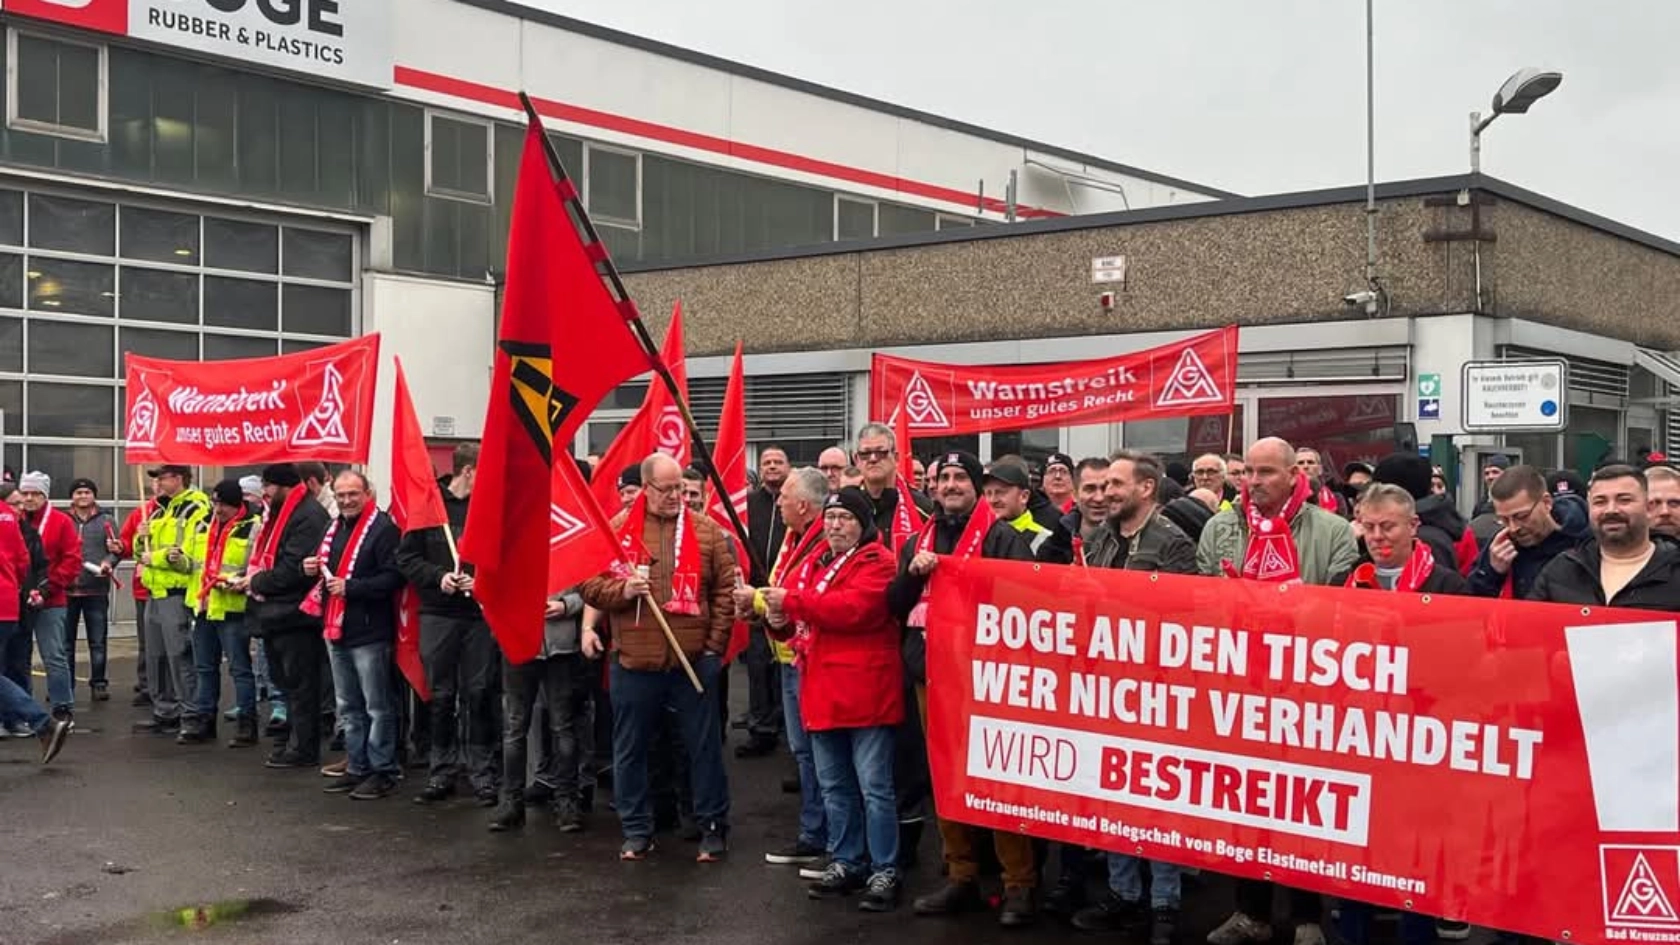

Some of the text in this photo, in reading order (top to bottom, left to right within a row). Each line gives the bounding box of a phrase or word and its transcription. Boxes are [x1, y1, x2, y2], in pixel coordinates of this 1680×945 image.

[149, 7, 344, 64] RUBBER & PLASTICS
[966, 366, 1138, 400] Warnstreik
[969, 389, 1135, 419] unser gutes Recht
[203, 423, 240, 449] gutes
[242, 418, 288, 443] Recht
[975, 603, 1409, 695] BOGE AN DEN TISCH
[972, 660, 1544, 780] WER NICHT VERHANDELT
[983, 727, 1359, 832] WIRD BESTREIKT
[965, 792, 1426, 894] Vertrauensleute und Belegschaft von Boge Elastmetall Simmern
[1605, 927, 1628, 940] Bad
